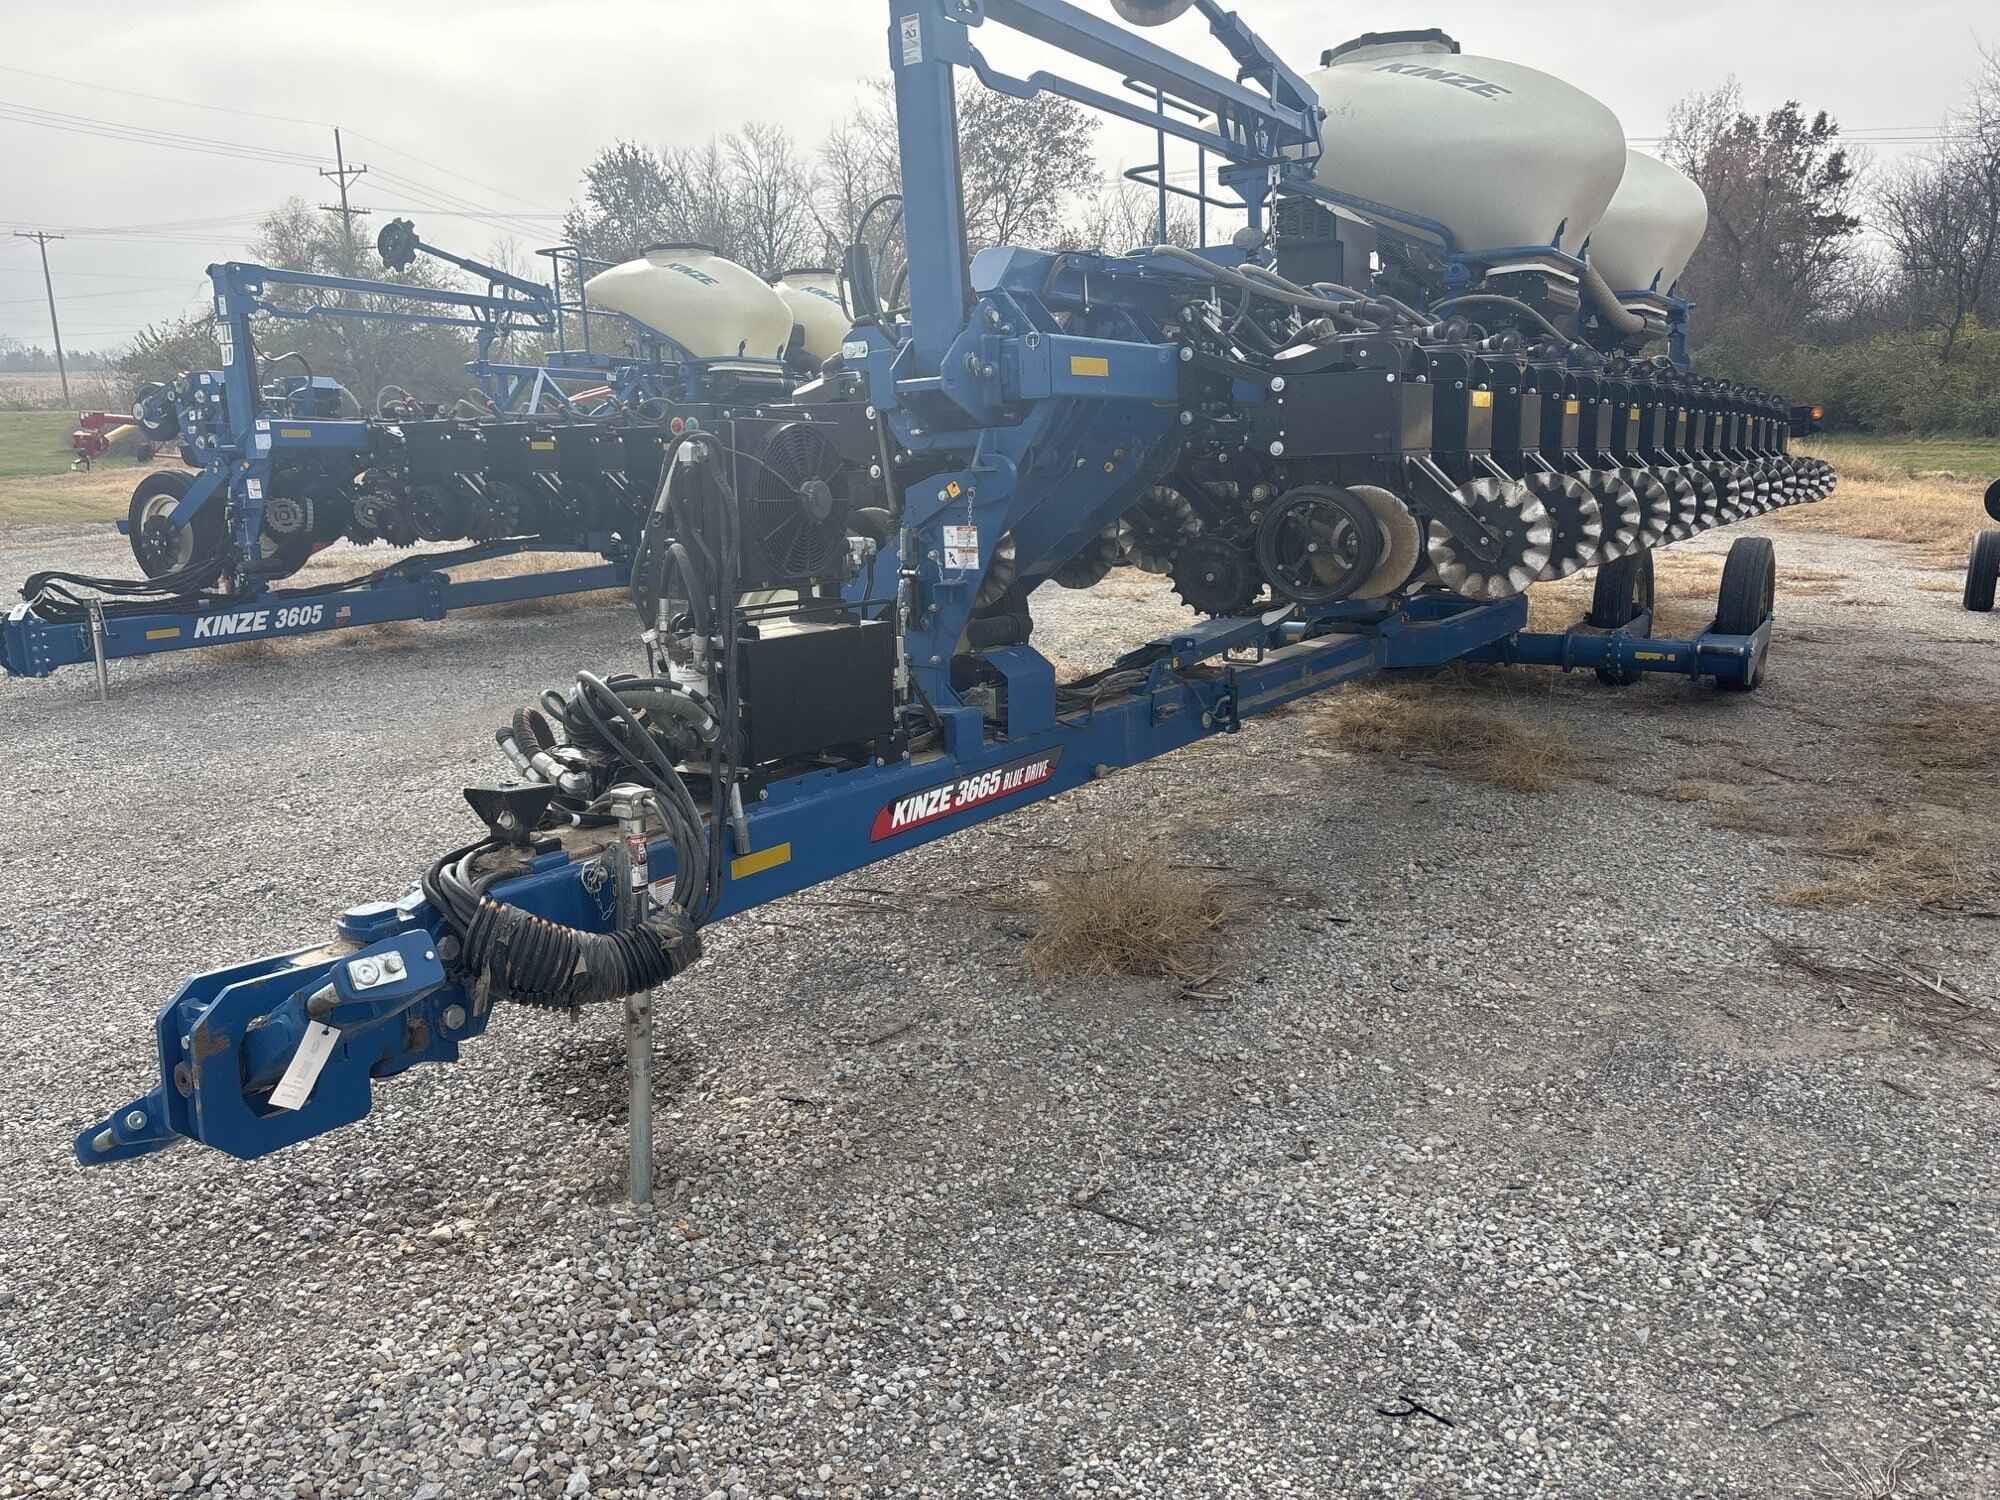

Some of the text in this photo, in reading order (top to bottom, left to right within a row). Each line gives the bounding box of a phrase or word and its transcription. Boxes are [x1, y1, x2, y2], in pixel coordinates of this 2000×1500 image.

[1373, 63, 1512, 98] KINZE
[664, 262, 720, 286] KINZE
[193, 604, 324, 639] KINZE 3605
[891, 759, 1049, 830] KINZE 3665 BLUE DRIVE
